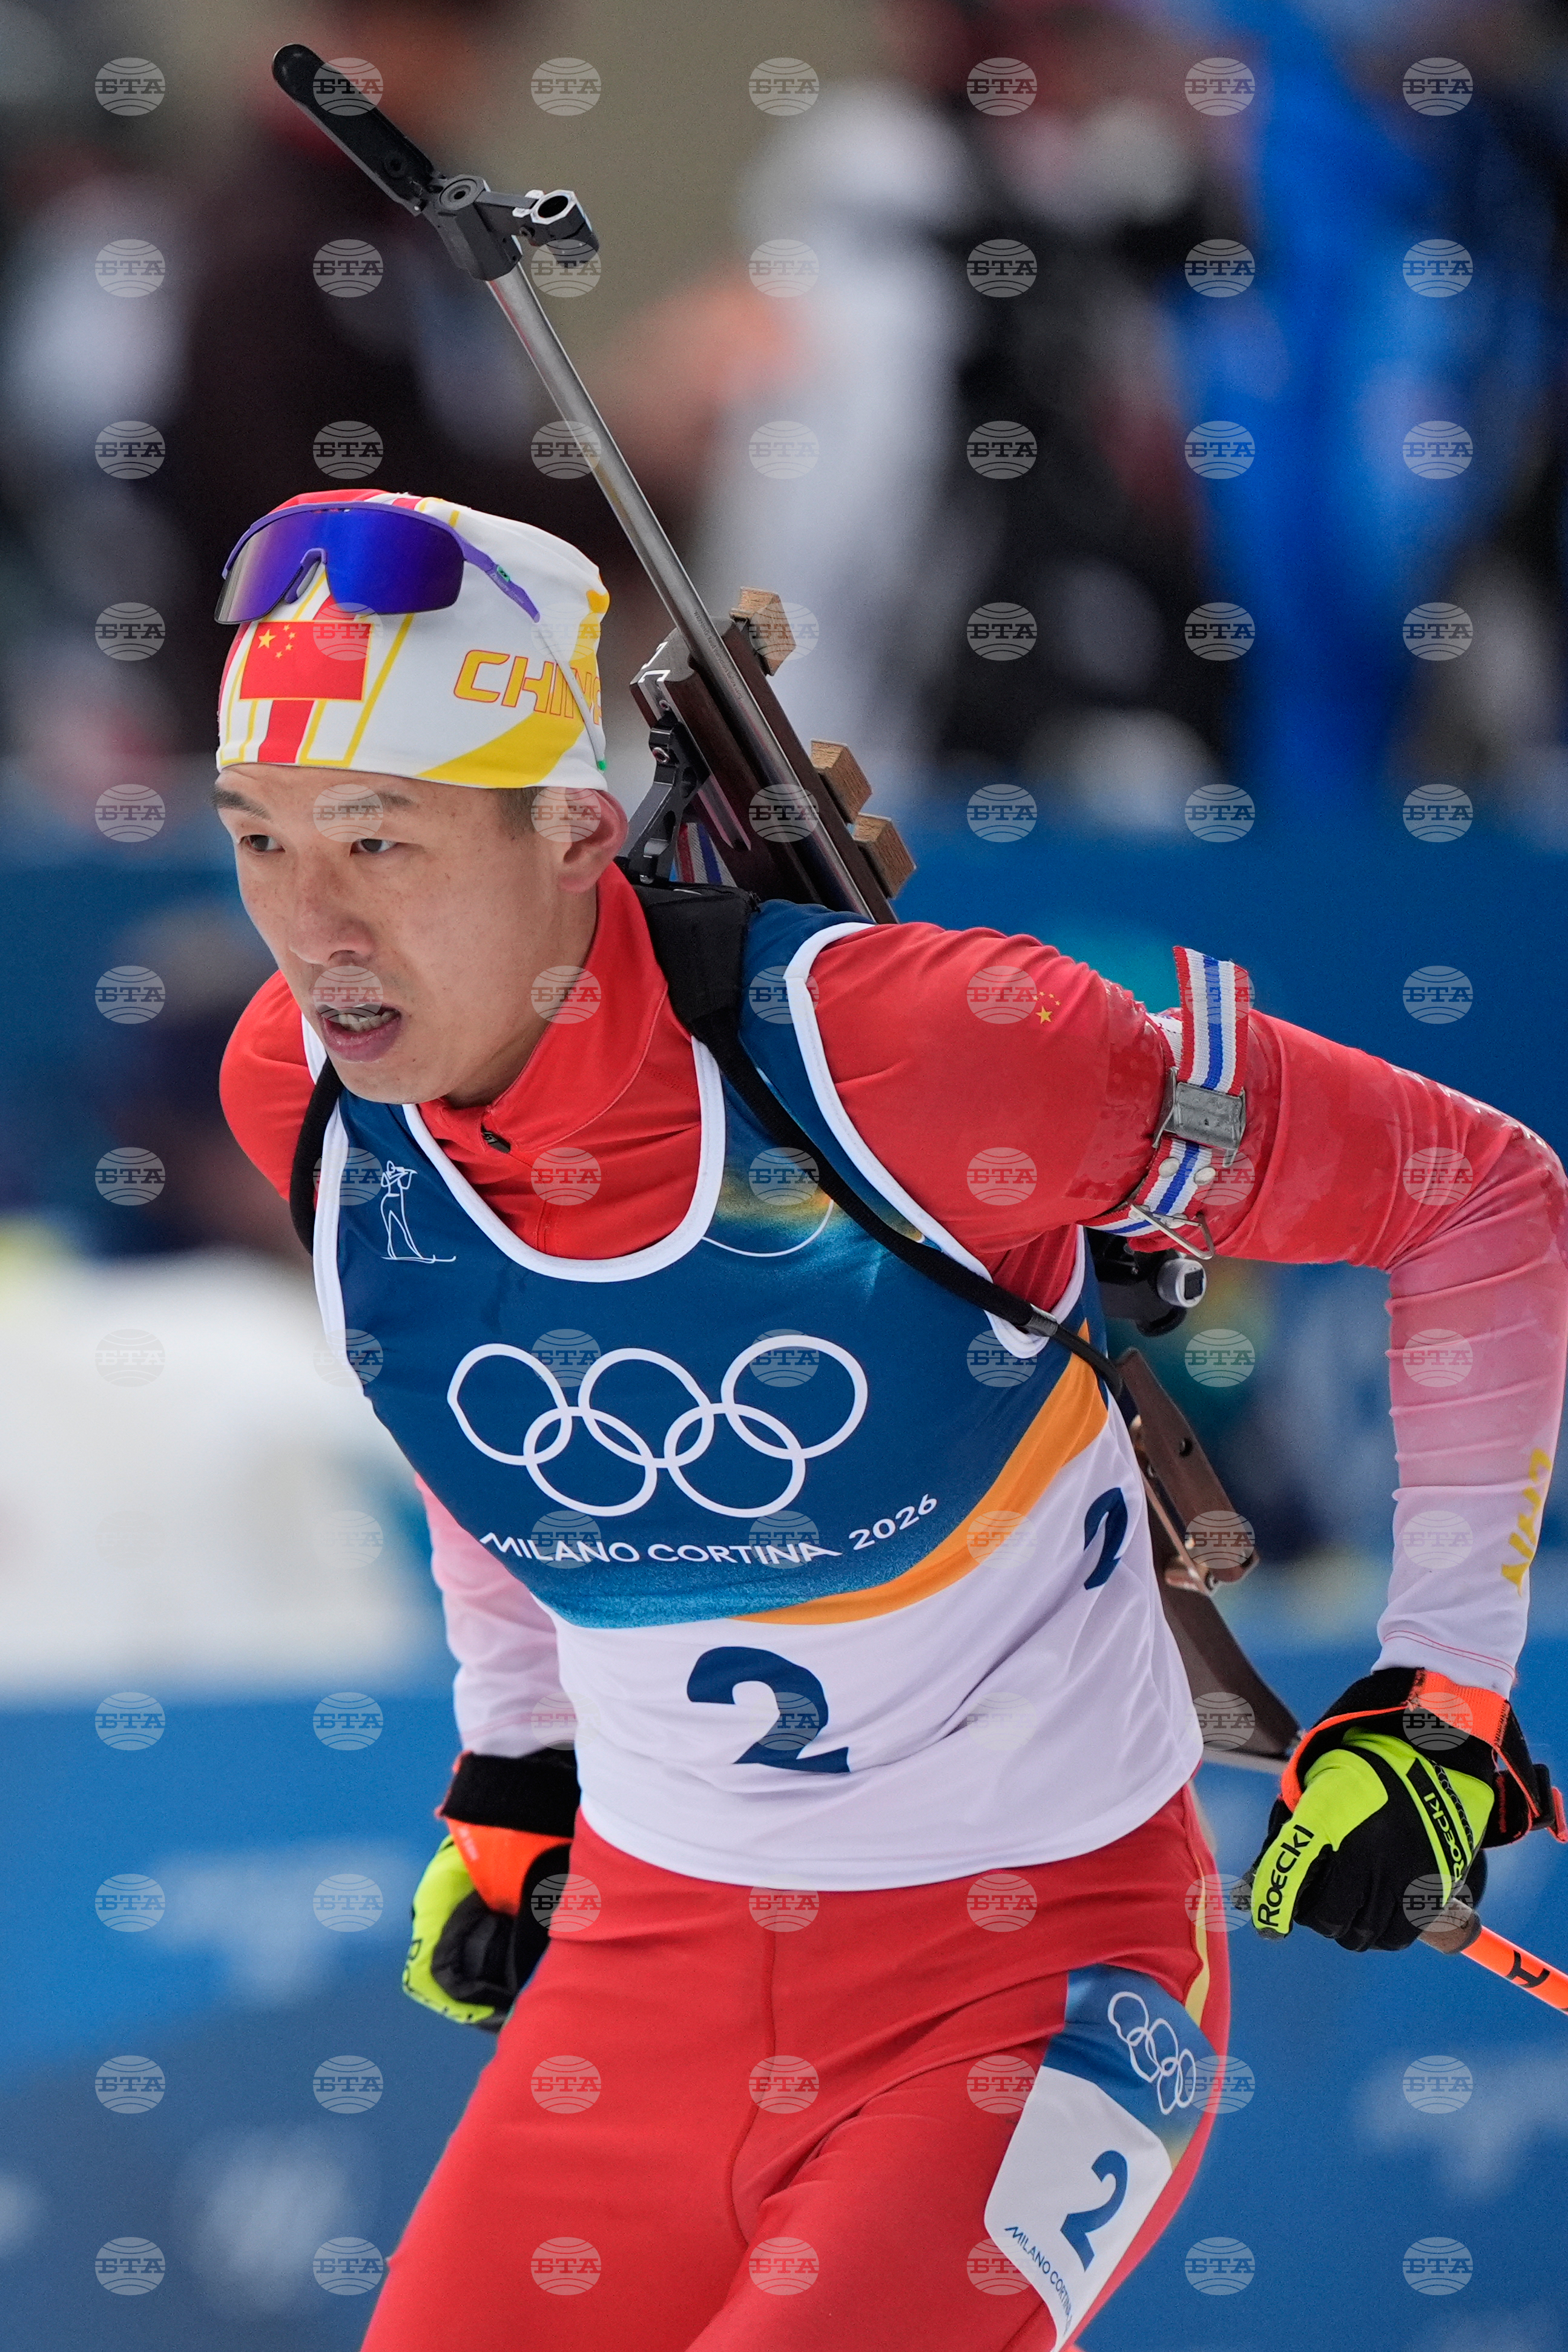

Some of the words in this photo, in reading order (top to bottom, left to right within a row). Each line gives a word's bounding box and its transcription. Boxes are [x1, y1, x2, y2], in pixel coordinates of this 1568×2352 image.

[479, 1532, 640, 1562] MILANO
[648, 1542, 843, 1565] CORTINA
[849, 1494, 938, 1550] 2026
[687, 1646, 851, 1774] 2
[1004, 2226, 1051, 2275] MILANO
[1060, 2150, 1128, 2273] 2
